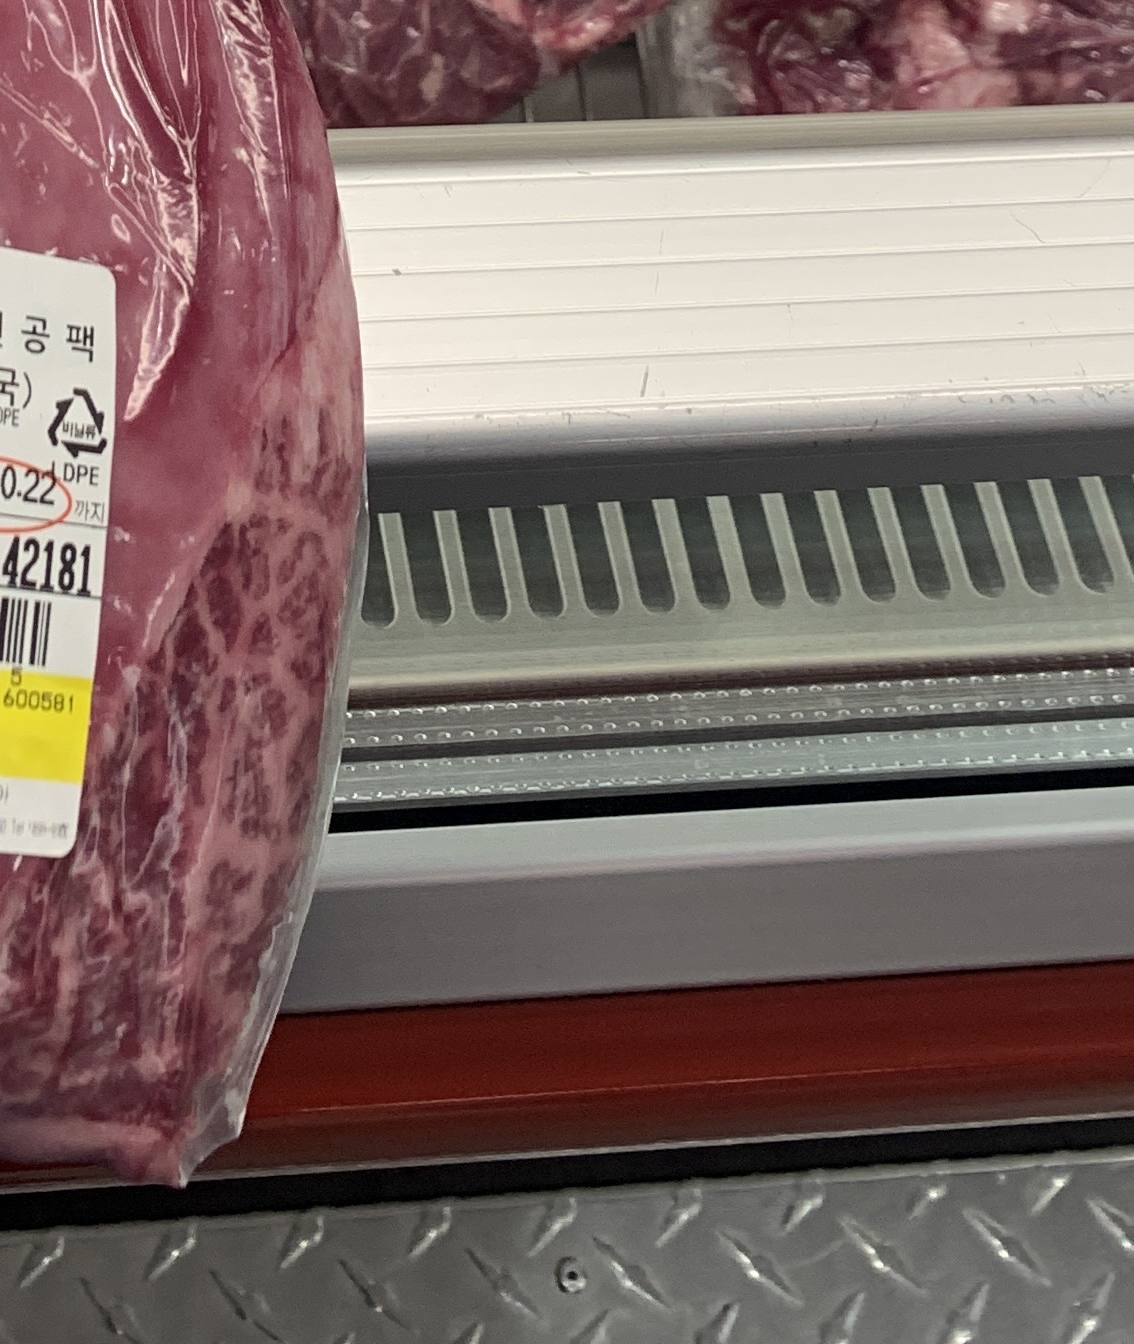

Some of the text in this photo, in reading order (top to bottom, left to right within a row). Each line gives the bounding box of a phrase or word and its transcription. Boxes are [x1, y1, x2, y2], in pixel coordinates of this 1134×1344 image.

[74, 499, 105, 523] 까지
[1, 535, 92, 596] 42181
[2, 688, 74, 714] 600581
